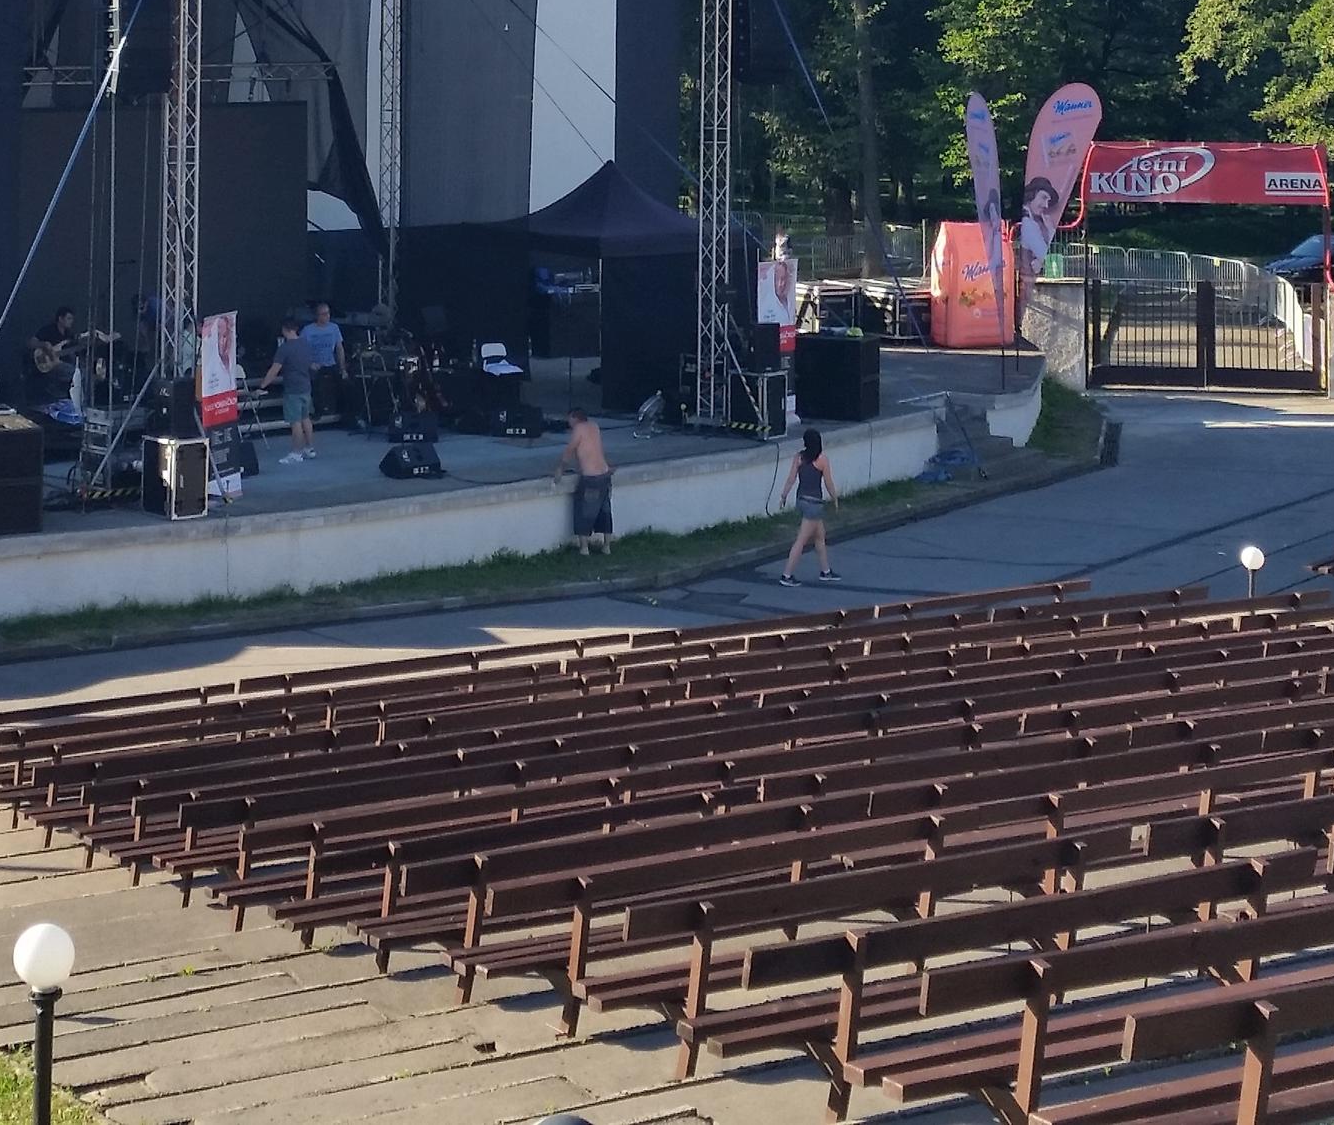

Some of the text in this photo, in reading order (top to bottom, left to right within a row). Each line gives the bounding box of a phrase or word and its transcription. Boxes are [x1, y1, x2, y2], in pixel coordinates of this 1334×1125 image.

[1131, 156, 1188, 172] letní
[1090, 172, 1180, 195] KINO
[1267, 178, 1323, 189] ARENA
